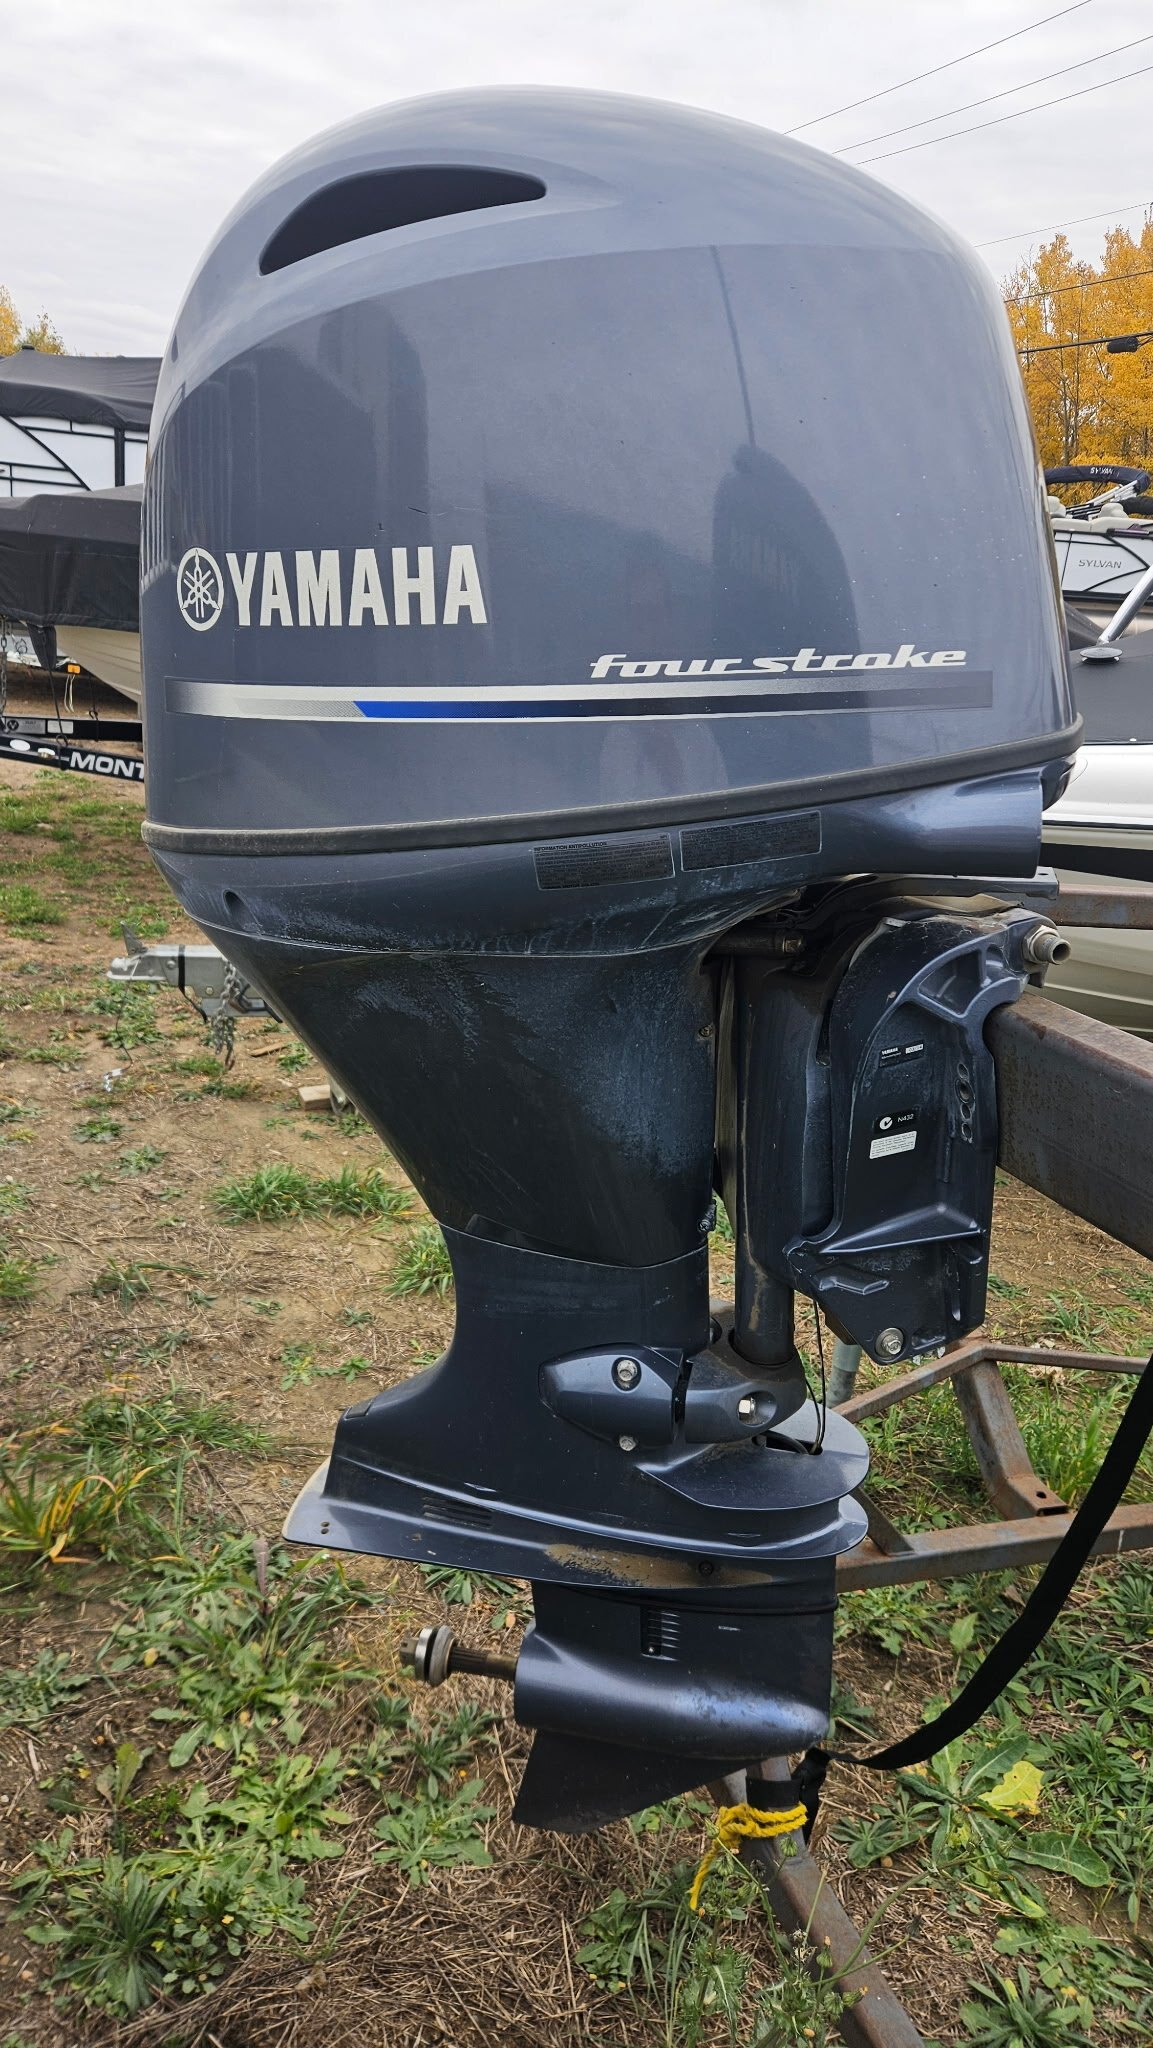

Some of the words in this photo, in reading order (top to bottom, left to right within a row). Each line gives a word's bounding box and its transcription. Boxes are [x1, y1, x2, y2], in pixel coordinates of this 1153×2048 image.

[1079, 559, 1122, 569] SYLVAN
[226, 544, 489, 627] YAMAHA
[590, 653, 743, 679] four
[752, 644, 967, 673] stroke
[897, 1113, 915, 1123] N432
